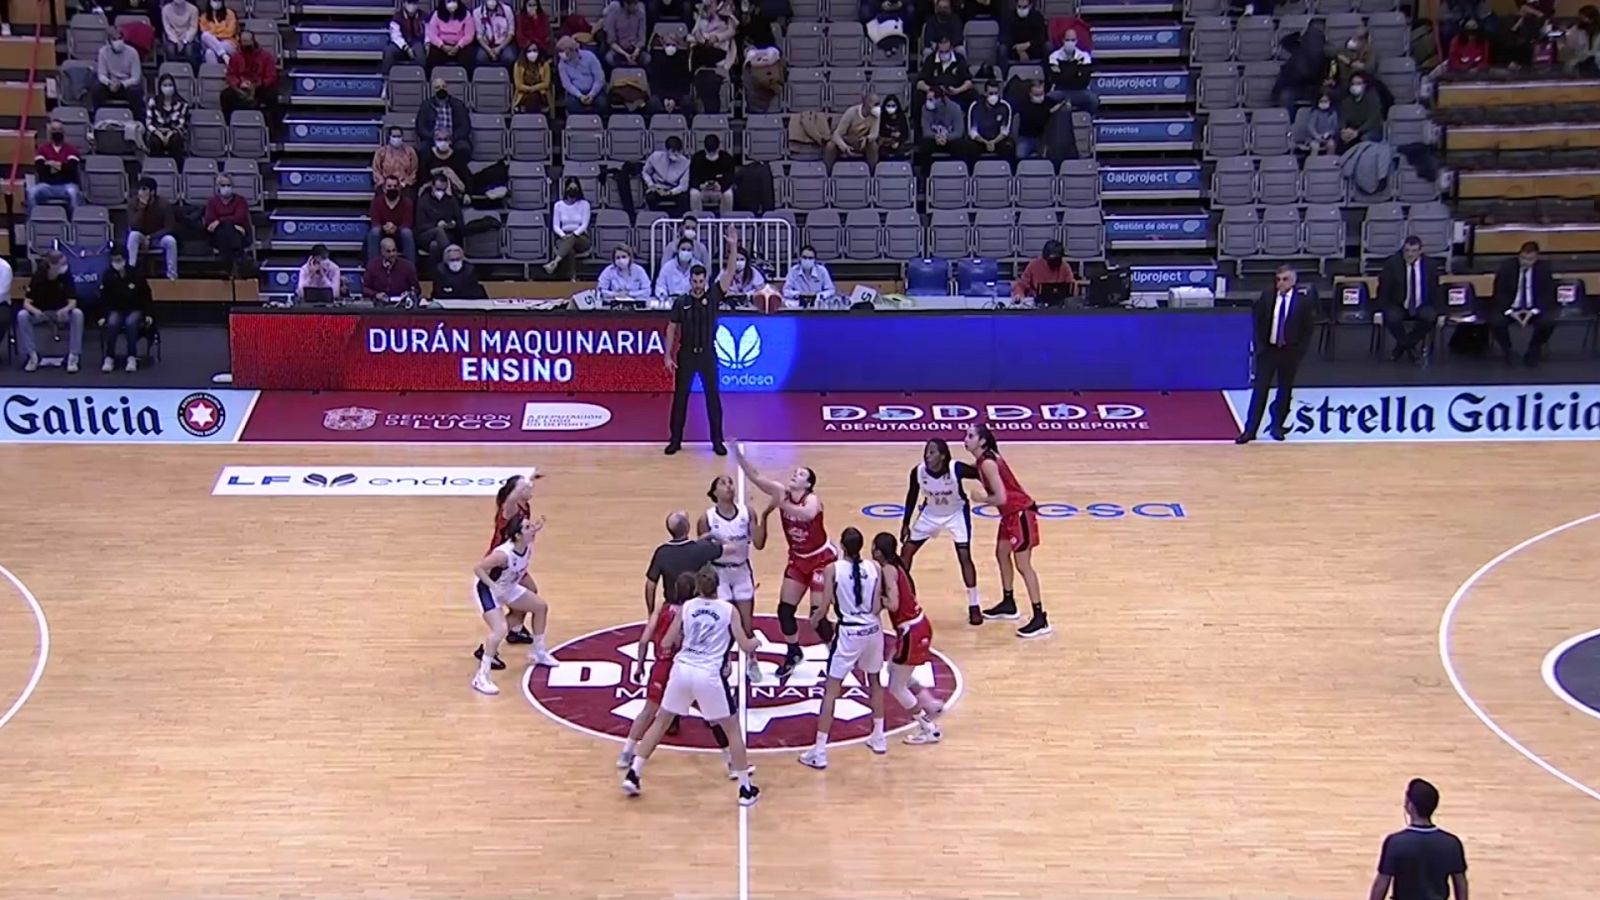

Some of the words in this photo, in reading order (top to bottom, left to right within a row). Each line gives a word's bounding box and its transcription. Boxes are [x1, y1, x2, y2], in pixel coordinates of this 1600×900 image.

[1097, 77, 1157, 90] Galiproject
[1100, 126, 1139, 136] Proyectos
[1106, 172, 1169, 184] Galiproject
[1113, 221, 1144, 231] Gestión
[1145, 222, 1155, 231] de
[1131, 270, 1182, 284] liproject
[368, 322, 470, 353] DURÁN
[481, 329, 665, 358] MAQUINARIA
[3, 393, 164, 436] Galicia
[413, 419, 511, 430] LUGO
[825, 423, 837, 431] A
[985, 422, 1033, 431] LUGO
[1067, 421, 1150, 431] DEPORTE
[861, 502, 1186, 519] edesa
